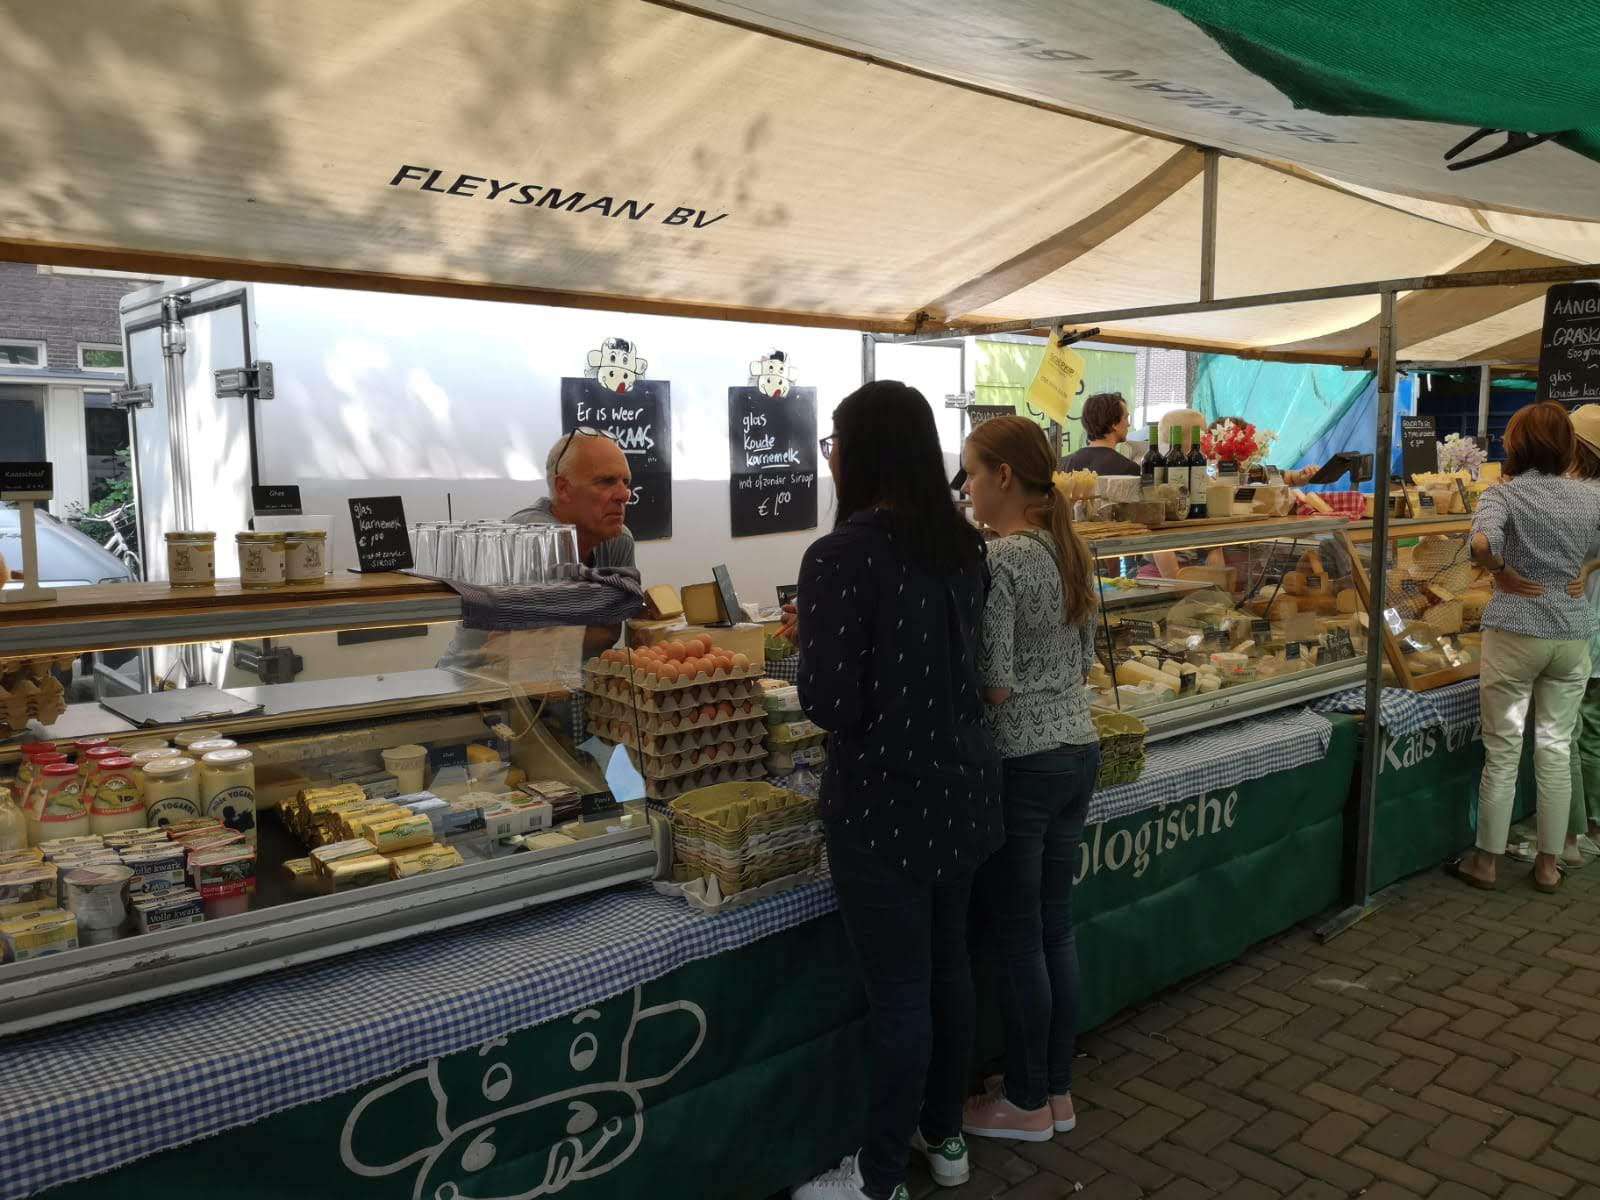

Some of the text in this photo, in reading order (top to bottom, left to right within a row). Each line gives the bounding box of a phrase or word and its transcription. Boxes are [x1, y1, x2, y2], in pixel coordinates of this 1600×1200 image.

[389, 164, 729, 230] FLEYSMAN BV
[576, 402, 592, 422] Er
[596, 406, 608, 421] is
[742, 412, 768, 434] glas
[746, 447, 801, 468] karnemelk
[354, 503, 373, 519] glas
